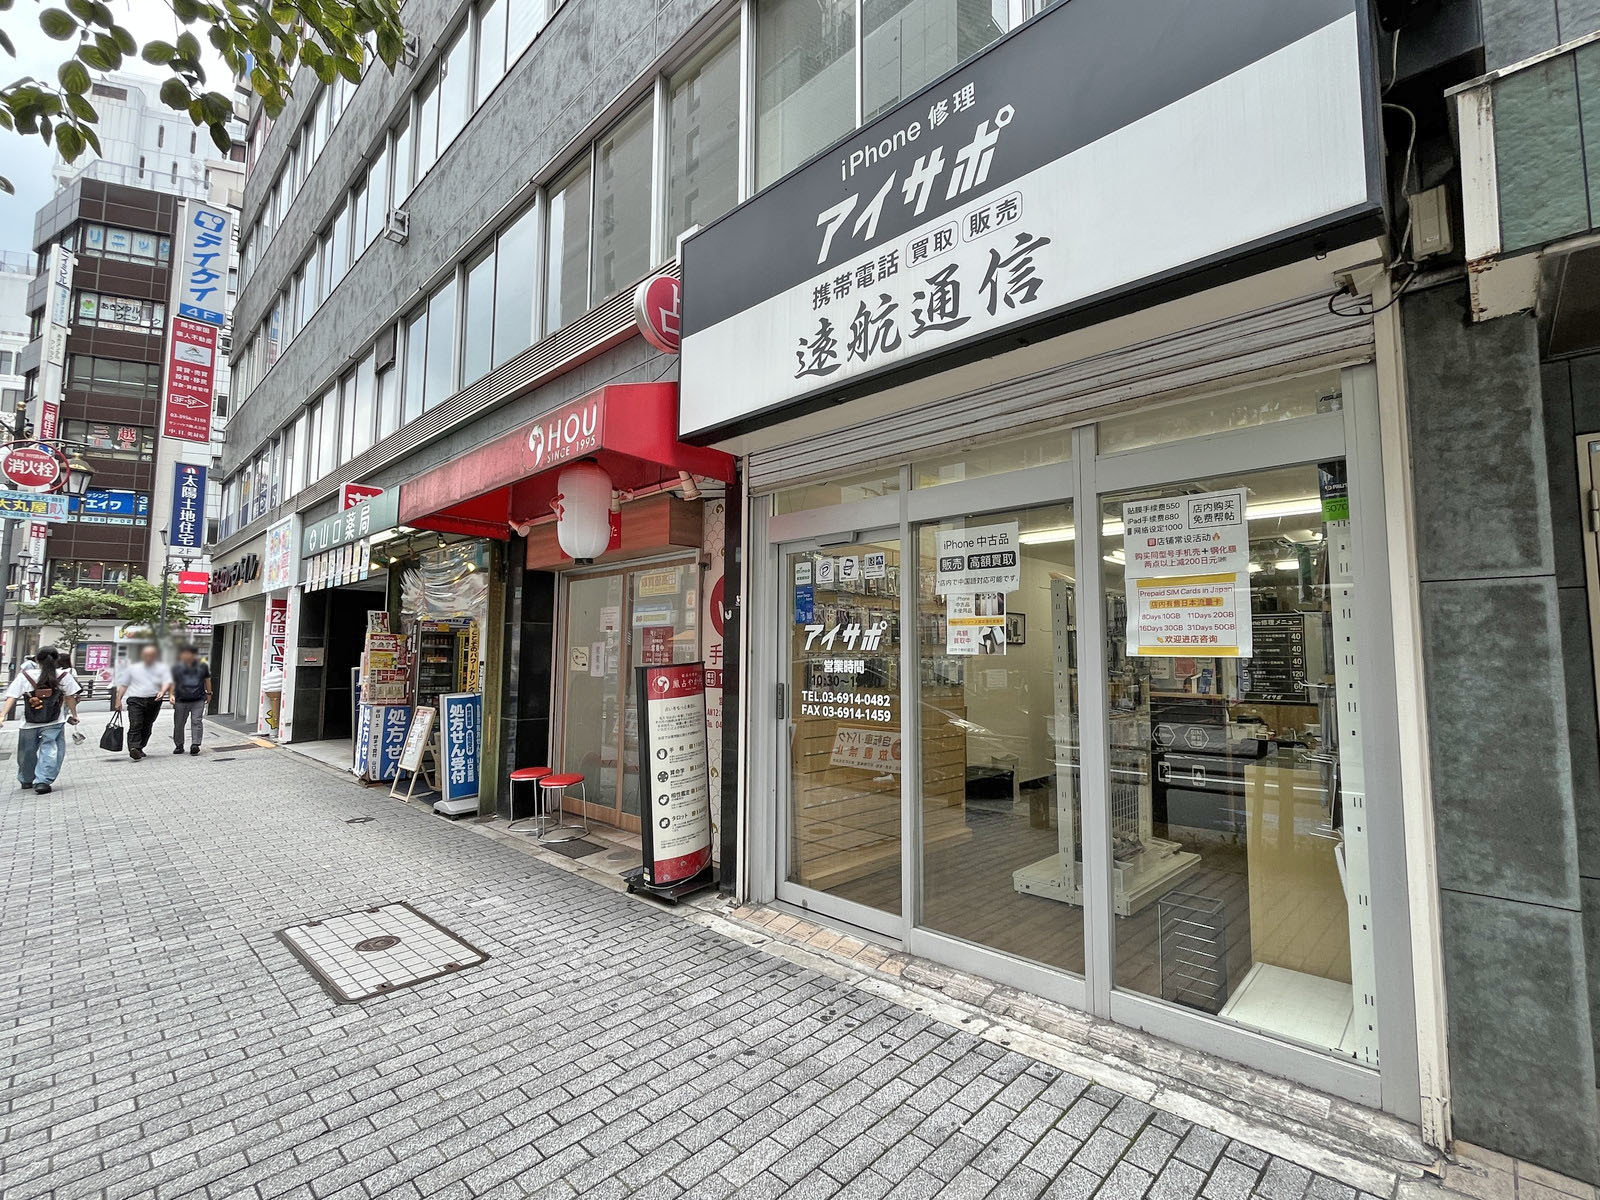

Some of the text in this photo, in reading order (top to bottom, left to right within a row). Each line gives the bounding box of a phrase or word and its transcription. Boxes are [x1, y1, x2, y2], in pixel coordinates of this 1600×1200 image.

[840, 81, 976, 181] iPhone 修理
[815, 103, 1015, 265] アイサポ
[811, 196, 1018, 311] 携帯電話 買取 販売
[190, 232, 223, 302] テイケイ
[186, 308, 216, 319] 4F
[793, 231, 1052, 380] 遠航通信
[548, 402, 598, 452] HOU
[547, 434, 596, 464] SINCE 1995
[7, 458, 55, 477] 消火栓
[85, 499, 122, 510] エイワ
[178, 474, 199, 546] 太陽土地住宅
[319, 504, 371, 549] 山口薬局
[943, 533, 1009, 550] iPhone 中古品
[941, 553, 1014, 571] 販売 高額買取
[1139, 589, 1166, 598] Prepaid
[1180, 587, 1201, 595] Cards
[1210, 586, 1233, 595] Japan
[1187, 612, 1212, 620] 11Days
[804, 621, 888, 651] アイサポ
[1187, 624, 1213, 632] 31Days
[1214, 623, 1235, 631] 50GB
[709, 643, 724, 665] 手
[823, 659, 865, 674] 営業時間
[1292, 670, 1304, 678] 120
[802, 690, 891, 707] TEL.03-6914-0482
[801, 704, 891, 722] FAX 03-6914-1459
[383, 708, 407, 778] 処方せん
[449, 704, 466, 785] 処方せん受付
